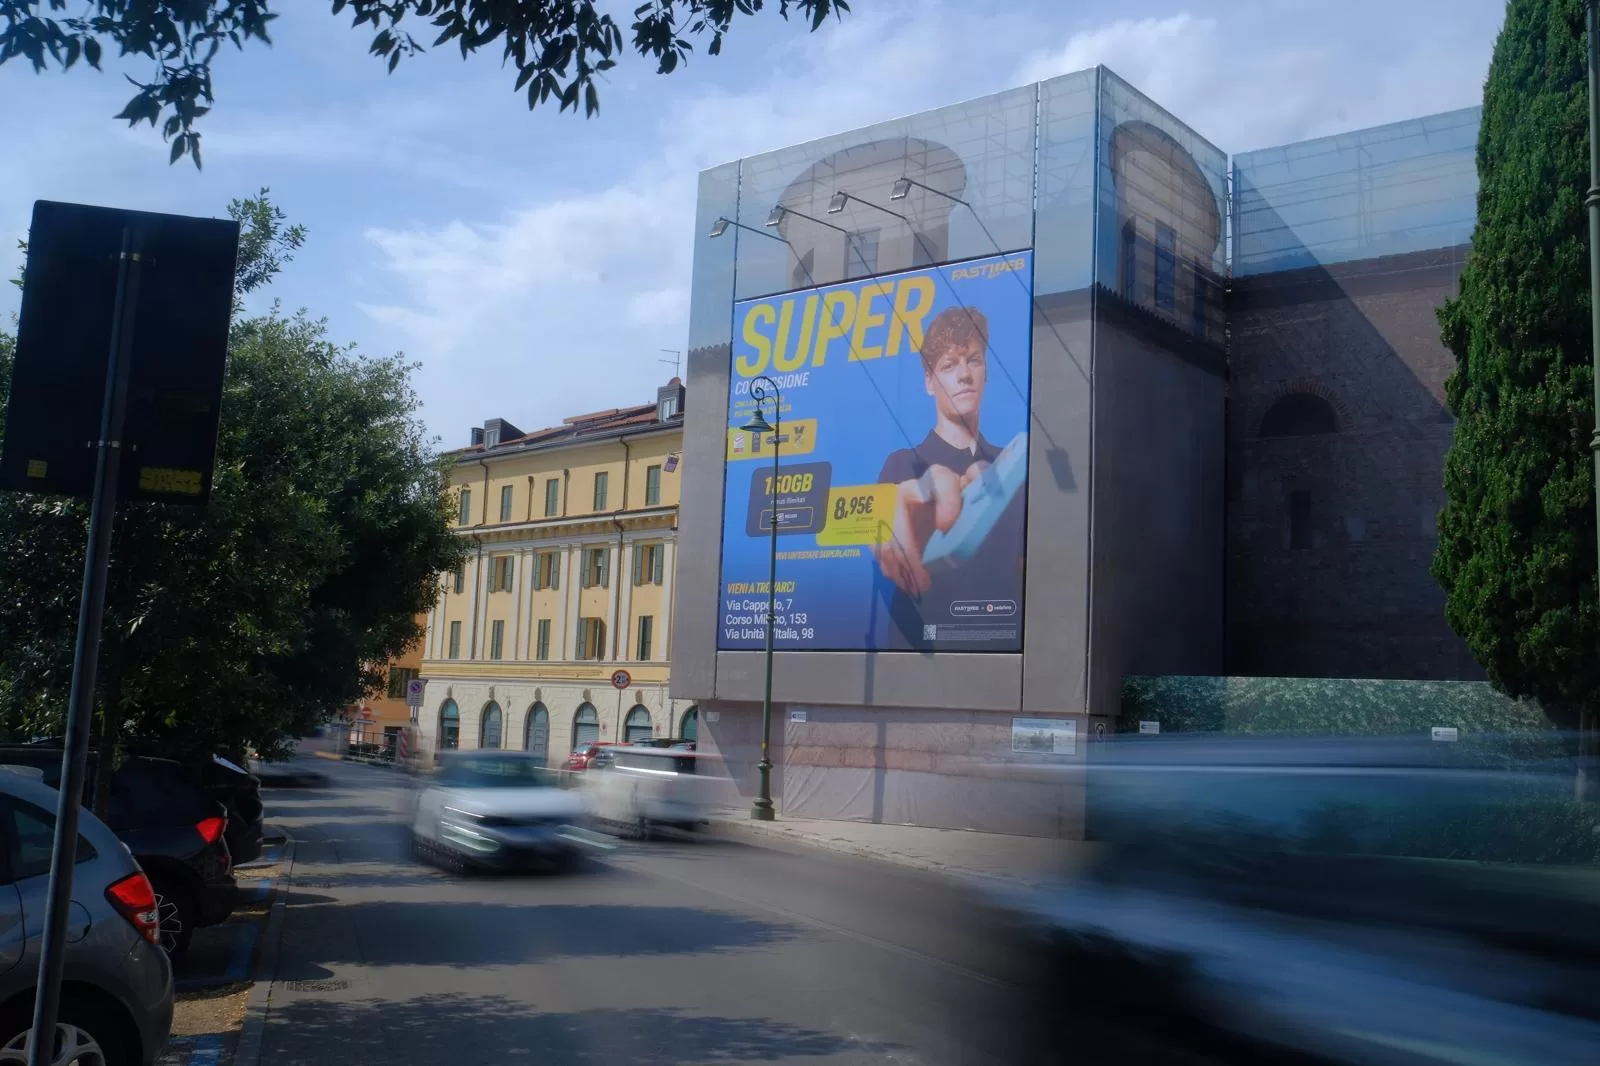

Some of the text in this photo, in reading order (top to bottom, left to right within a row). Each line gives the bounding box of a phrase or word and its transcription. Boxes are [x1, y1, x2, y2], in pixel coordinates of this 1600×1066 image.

[735, 276, 936, 377] SUPER
[735, 372, 810, 395] CONNESSIONE
[834, 495, 874, 520] 8,95€
[748, 583, 755, 594] A
[756, 581, 795, 593] TROARCI
[726, 599, 793, 612] Via Cappelo, 7
[725, 613, 807, 626] Corso Milno, 153
[725, 628, 814, 641] Via Unità 'Italia, 98
